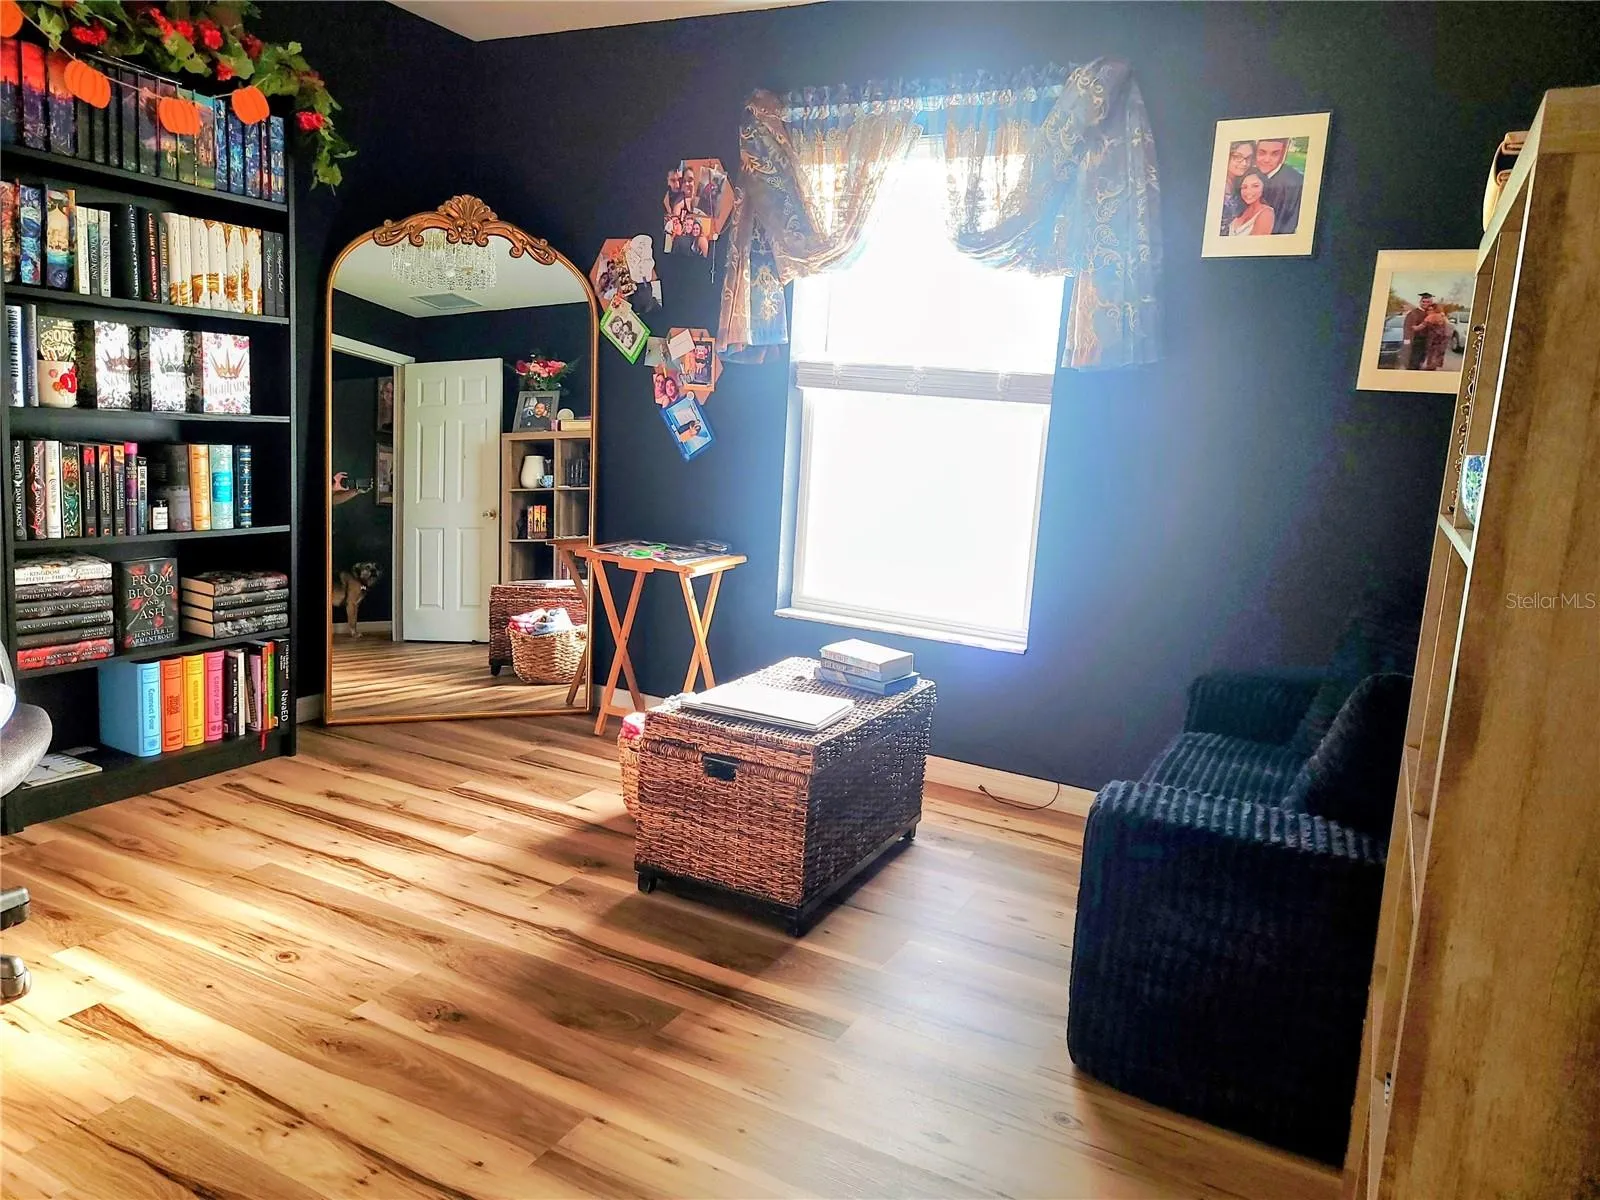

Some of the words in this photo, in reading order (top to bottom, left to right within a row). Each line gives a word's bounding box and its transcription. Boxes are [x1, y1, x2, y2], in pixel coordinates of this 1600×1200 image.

[90, 236, 98, 262] WICKED
[91, 263, 99, 280] KING
[7, 309, 19, 339] STARSIDE
[131, 573, 170, 586] FROM
[128, 585, 174, 600] BLOOD
[139, 606, 166, 620] ASH
[130, 632, 175, 645] ARMENTROUT
[134, 628, 166, 638] JENNIFER
[147, 688, 156, 714] Connect
[281, 689, 289, 722] NavaED
